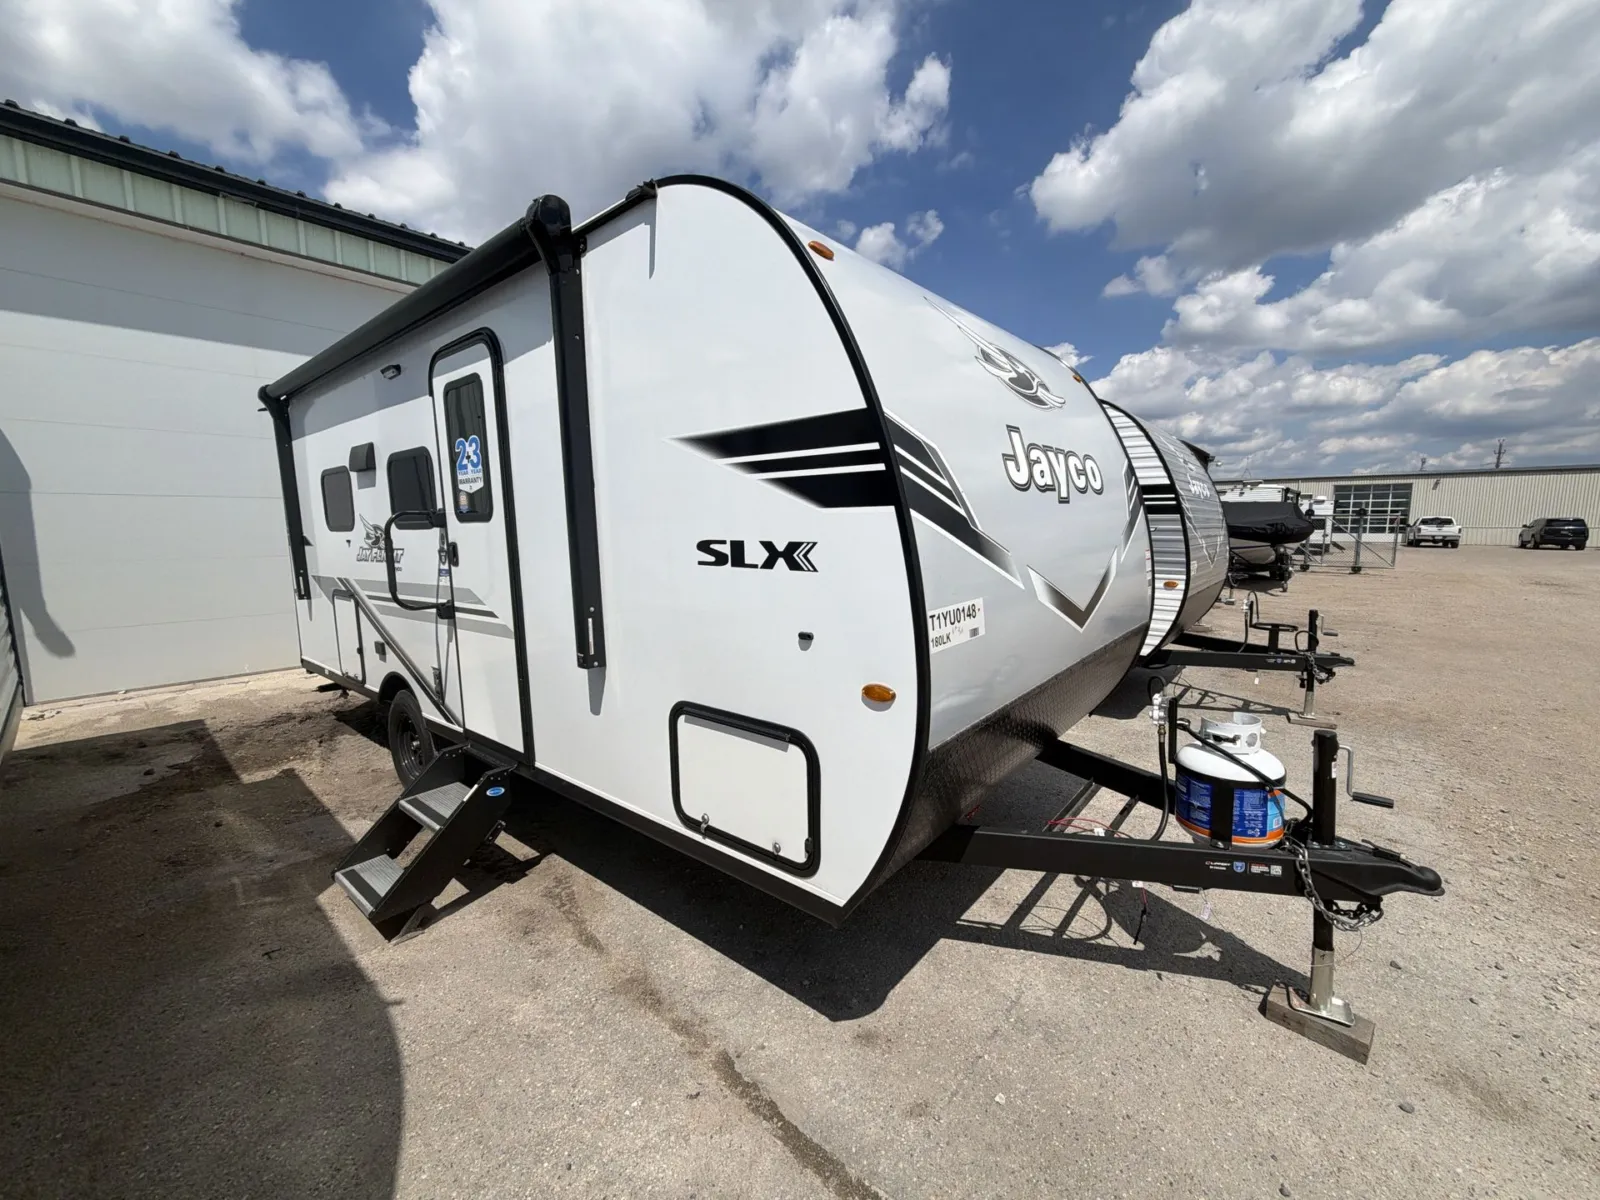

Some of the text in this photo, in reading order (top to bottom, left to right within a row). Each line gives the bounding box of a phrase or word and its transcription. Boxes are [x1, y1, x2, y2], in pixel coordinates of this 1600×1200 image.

[1001, 424, 1104, 504] Jayco
[356, 546, 404, 563] JAY FLIT
[696, 539, 819, 573] SLX
